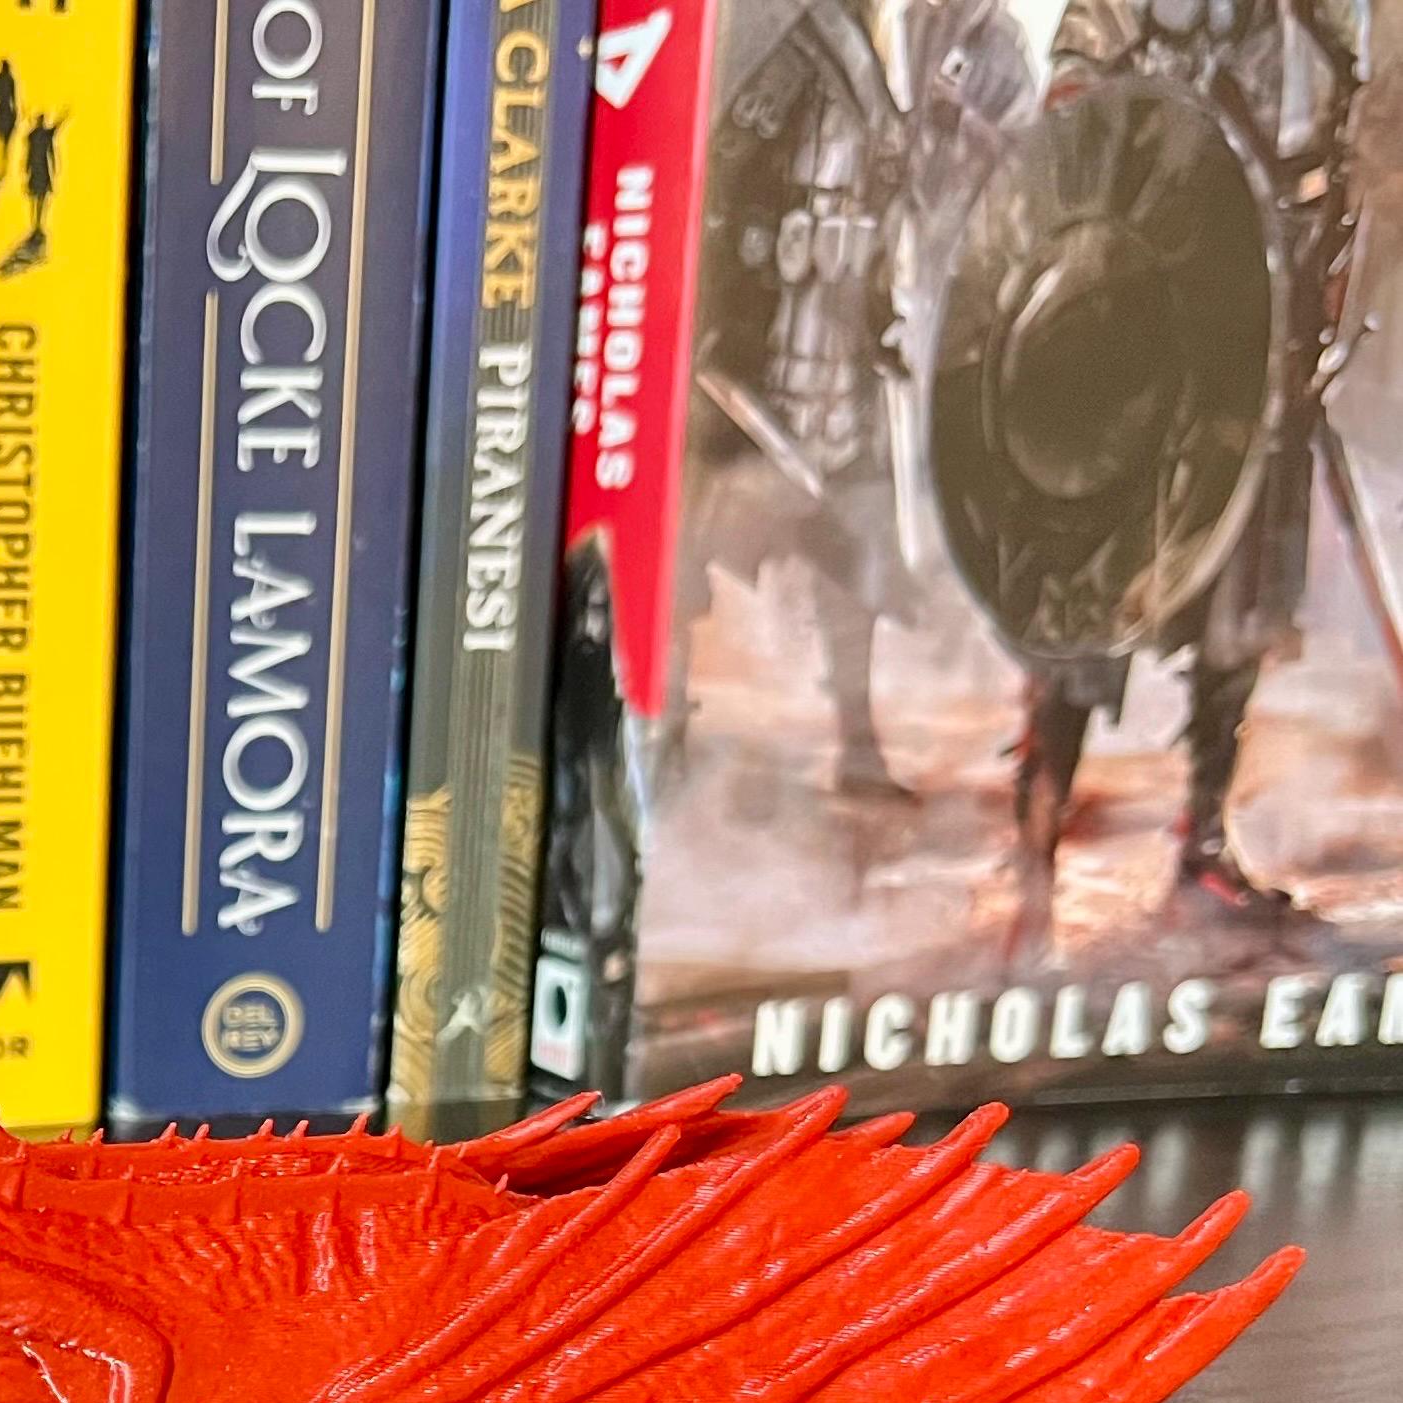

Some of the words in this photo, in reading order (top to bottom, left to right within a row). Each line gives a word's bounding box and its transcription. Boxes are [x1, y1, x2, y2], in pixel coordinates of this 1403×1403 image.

[252, 0, 323, 116] OF
[480, 31, 549, 311] CLARKE
[206, 147, 347, 472] LOCKE
[595, 164, 655, 491] NICHOLAS
[463, 341, 533, 652] PIRANESI
[217, 511, 317, 937] LAMORA
[751, 976, 1215, 1077] NICHOLAS
